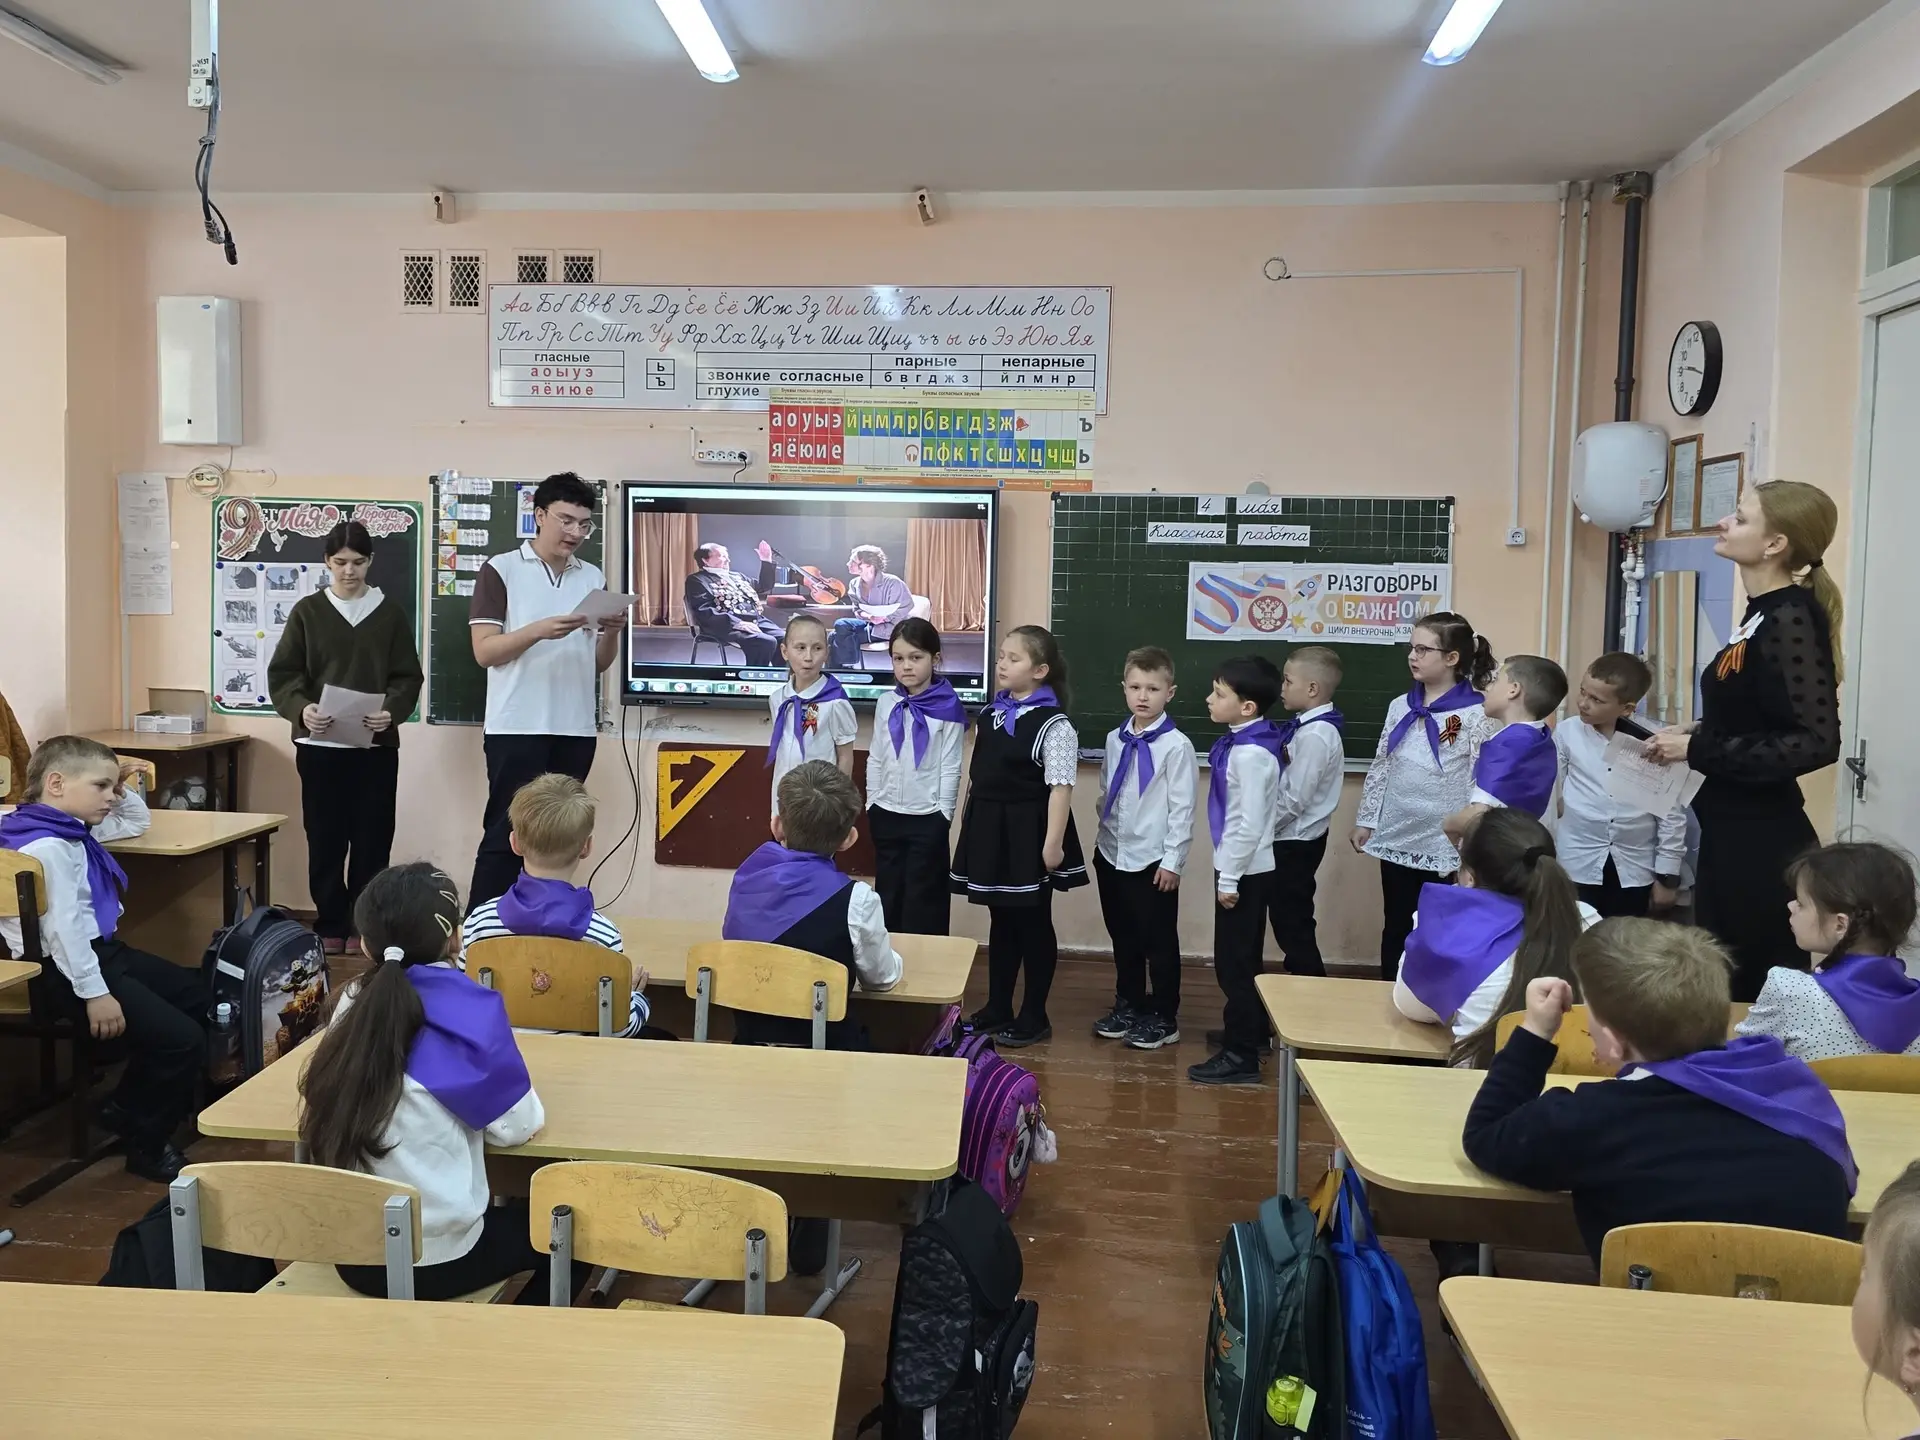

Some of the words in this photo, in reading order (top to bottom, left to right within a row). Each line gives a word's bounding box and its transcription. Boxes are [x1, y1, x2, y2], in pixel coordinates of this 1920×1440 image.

[500, 292, 532, 312] Аа
[537, 293, 572, 312] Бб
[570, 293, 615, 313] Ввв
[620, 294, 643, 313] Гг
[647, 294, 680, 323] Дд
[685, 295, 707, 315] Ее
[715, 292, 738, 315] Ёё
[744, 296, 792, 315] Жж
[796, 295, 820, 323] Зз
[826, 296, 859, 315] Ии
[864, 291, 897, 315] Йй
[901, 296, 932, 315] Кк
[938, 295, 973, 315] Лл
[977, 295, 1026, 315] Мм
[1031, 295, 1065, 316] Нн
[1071, 295, 1094, 316] Оо
[497, 322, 533, 341] Пп
[537, 322, 563, 349] Рр
[569, 322, 594, 341] Сс
[598, 323, 644, 342] Тт
[649, 323, 674, 352] Уу
[677, 324, 708, 351] Фф
[711, 324, 746, 344] Хх
[750, 324, 785, 349] Цц
[787, 325, 815, 344] Чч
[821, 325, 863, 345] Шш
[868, 326, 912, 351] Щщ
[918, 334, 939, 345] ъъ
[946, 335, 962, 345] ы
[968, 335, 987, 346] ьь
[992, 326, 1014, 346] Ээ
[1018, 325, 1058, 346] Юю
[1060, 325, 1095, 346] Яя
[534, 353, 590, 362] гласные
[895, 356, 957, 369] парные
[1002, 357, 1085, 369] непарные
[707, 371, 771, 381] звонкие
[779, 372, 864, 382] согласные
[708, 386, 759, 398] глухие
[1201, 497, 1211, 512] 4
[353, 503, 398, 522] Города
[219, 499, 264, 559] 9
[1149, 524, 1225, 539] Классная
[1328, 574, 1437, 593] РАЗГОВОРЫ
[1325, 600, 1337, 618] О
[1344, 601, 1431, 620] ВАЖНОМ
[1328, 626, 1349, 635] ЦИКЛ
